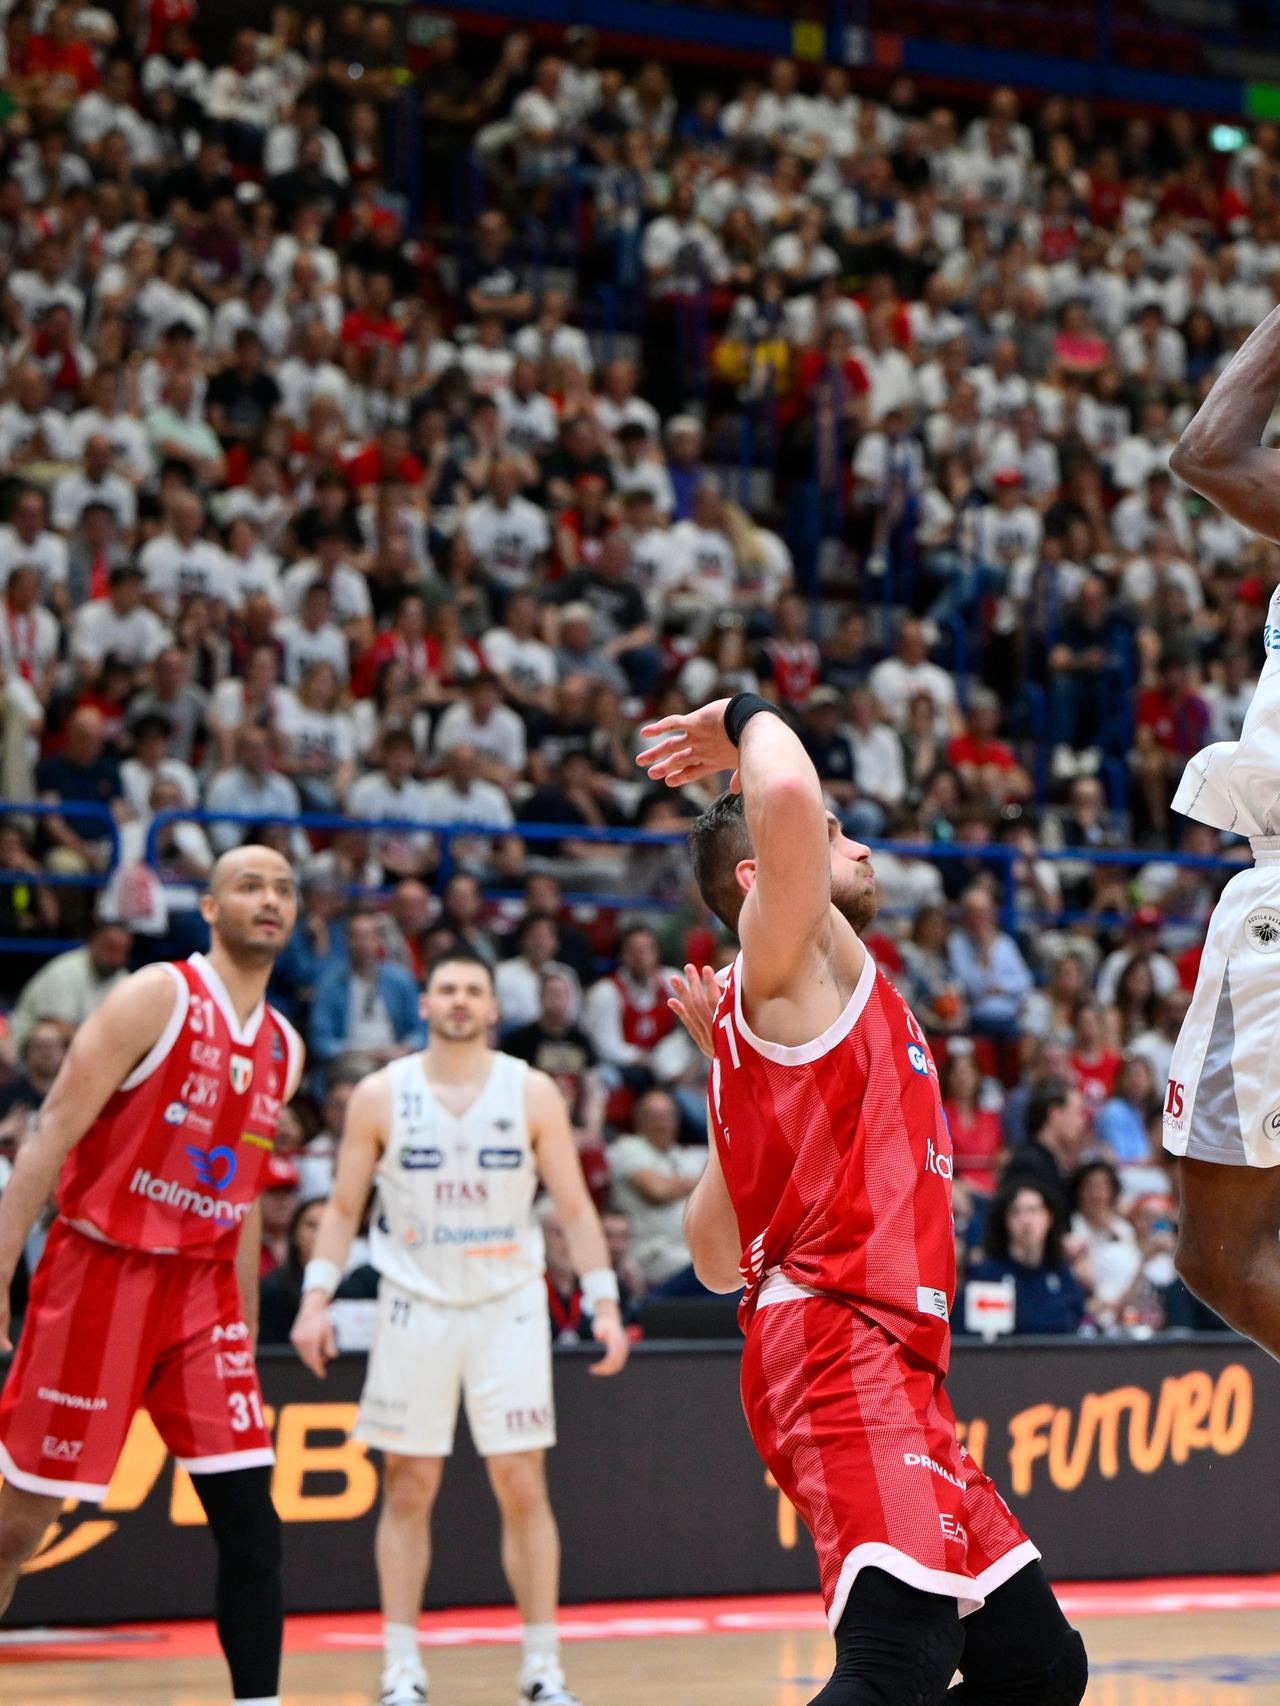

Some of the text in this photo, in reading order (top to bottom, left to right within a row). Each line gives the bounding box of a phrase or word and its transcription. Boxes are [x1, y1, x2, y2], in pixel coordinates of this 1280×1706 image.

[188, 995, 215, 1038] 31
[435, 1182, 489, 1204] ITAS
[228, 1391, 264, 1432] 31
[1007, 1363, 1253, 1496] FUTURO
